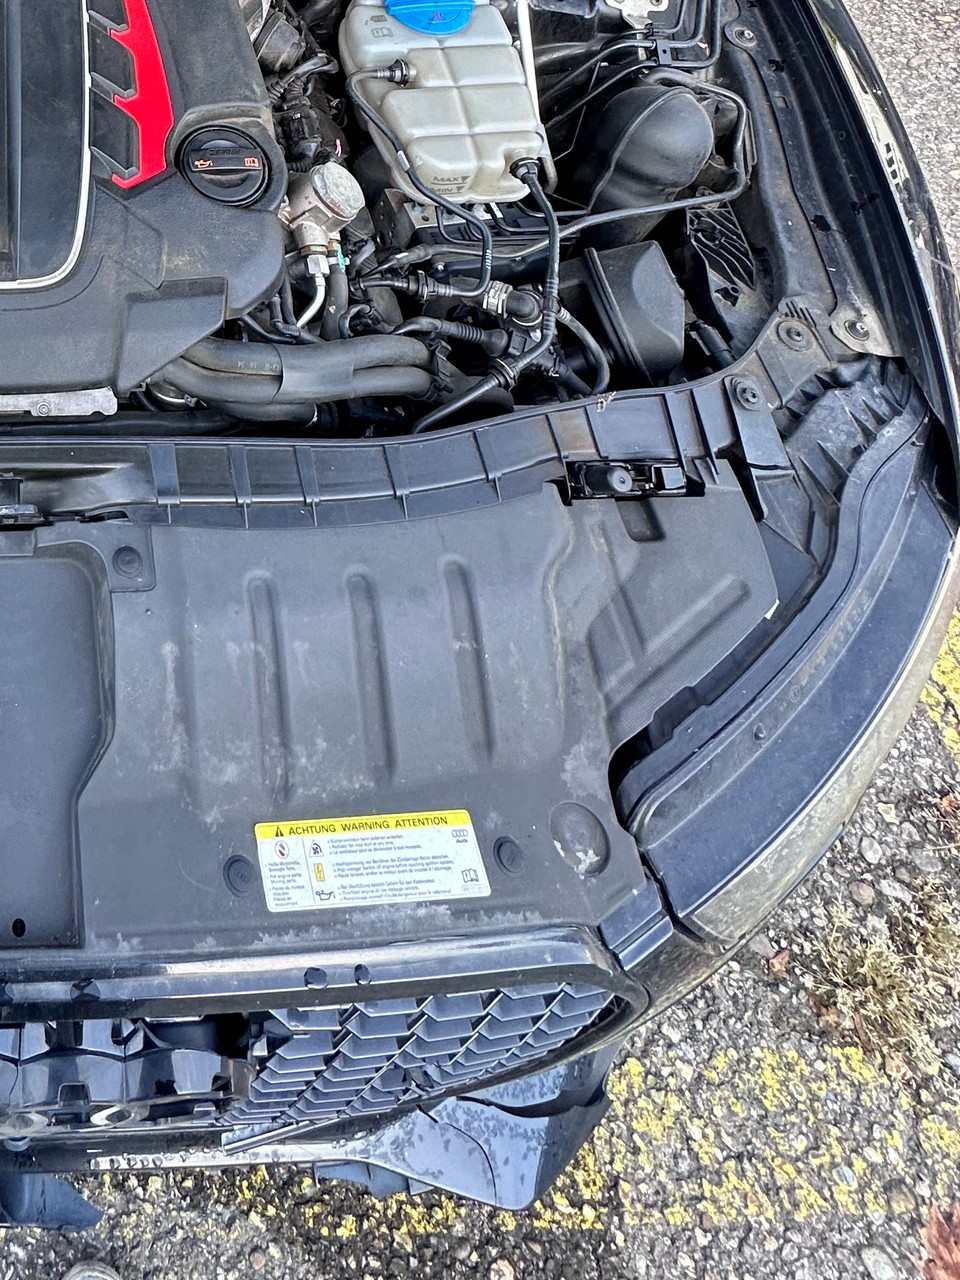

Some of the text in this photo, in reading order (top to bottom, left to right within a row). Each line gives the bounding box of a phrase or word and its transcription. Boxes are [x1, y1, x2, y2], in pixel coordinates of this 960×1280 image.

[288, 816, 448, 836] ACHTUNG WARNING ATTENTION
